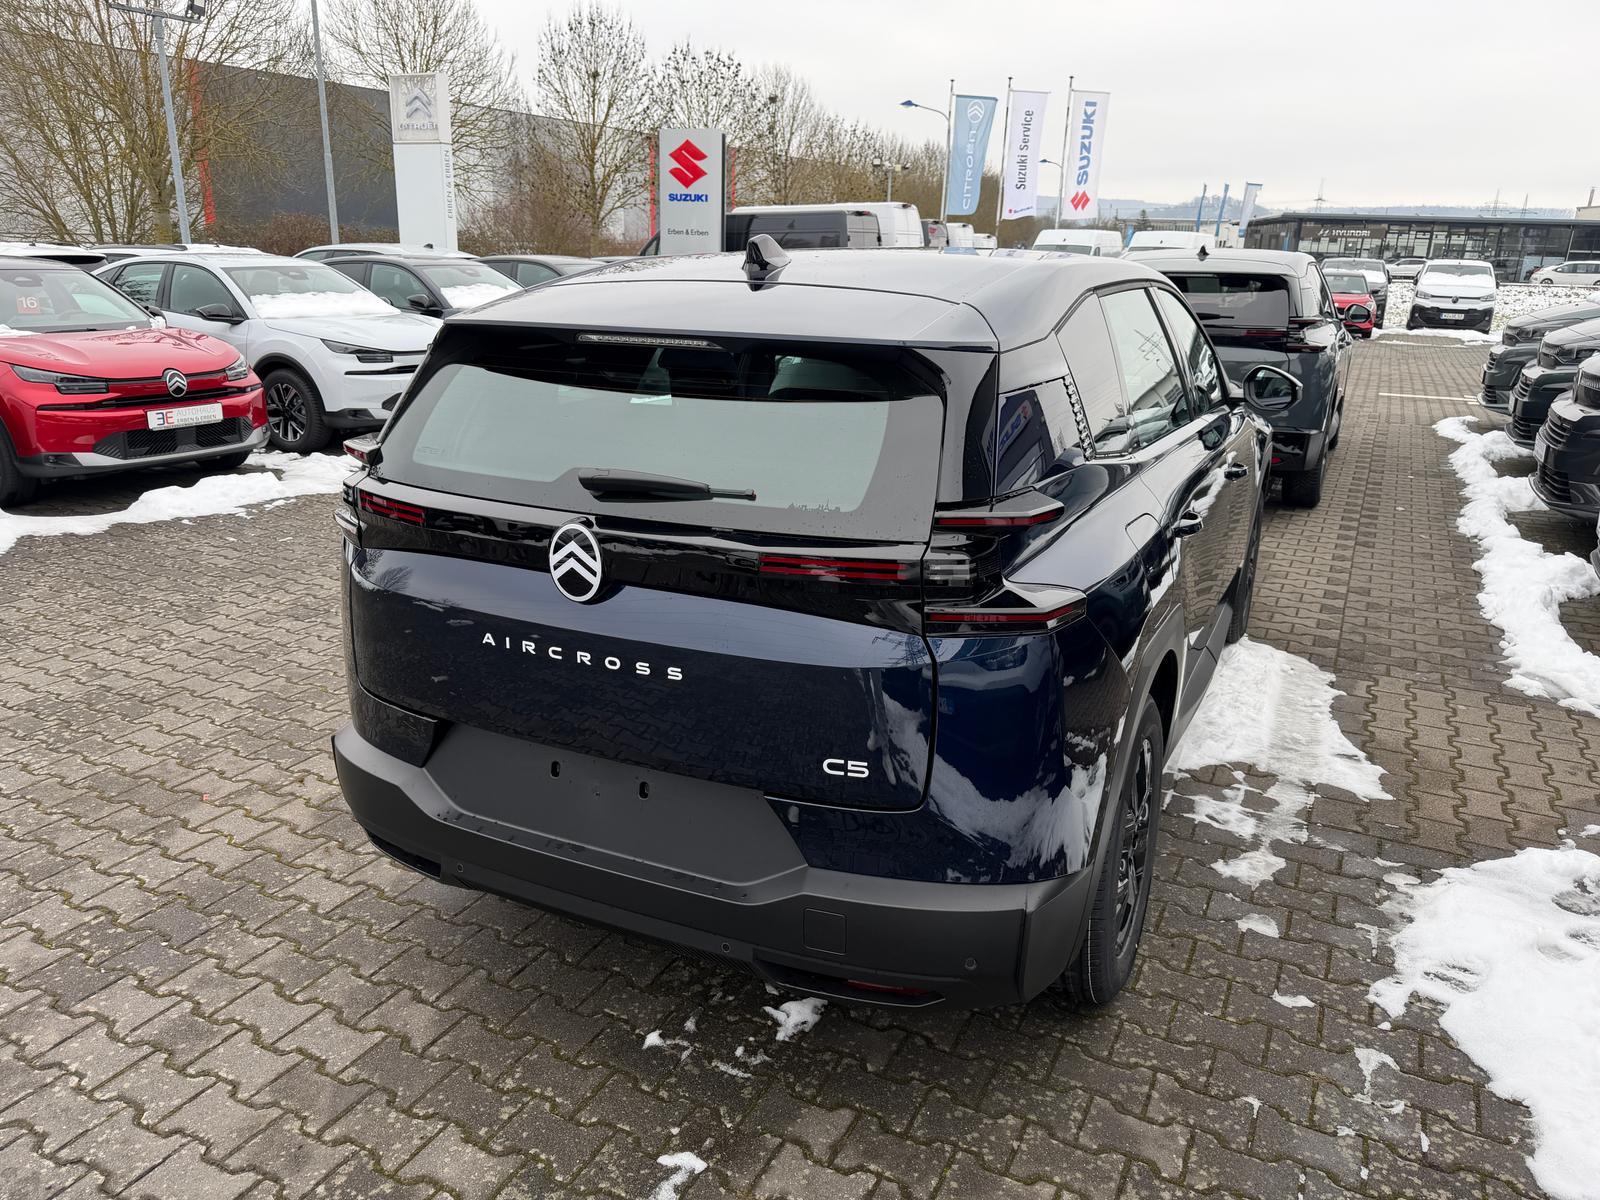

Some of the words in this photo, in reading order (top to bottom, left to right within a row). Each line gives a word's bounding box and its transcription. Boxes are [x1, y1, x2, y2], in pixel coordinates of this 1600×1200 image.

[1019, 110, 1034, 151] Service
[1077, 101, 1098, 186] SUZUKI
[1015, 155, 1028, 190] Suzuki
[668, 193, 708, 203] SUZUKI
[690, 229, 709, 237] Erben
[1332, 229, 1371, 237] HYUNDAI
[17, 296, 38, 309] 16
[482, 633, 683, 681] AIRCROSS
[822, 758, 870, 778] C5
